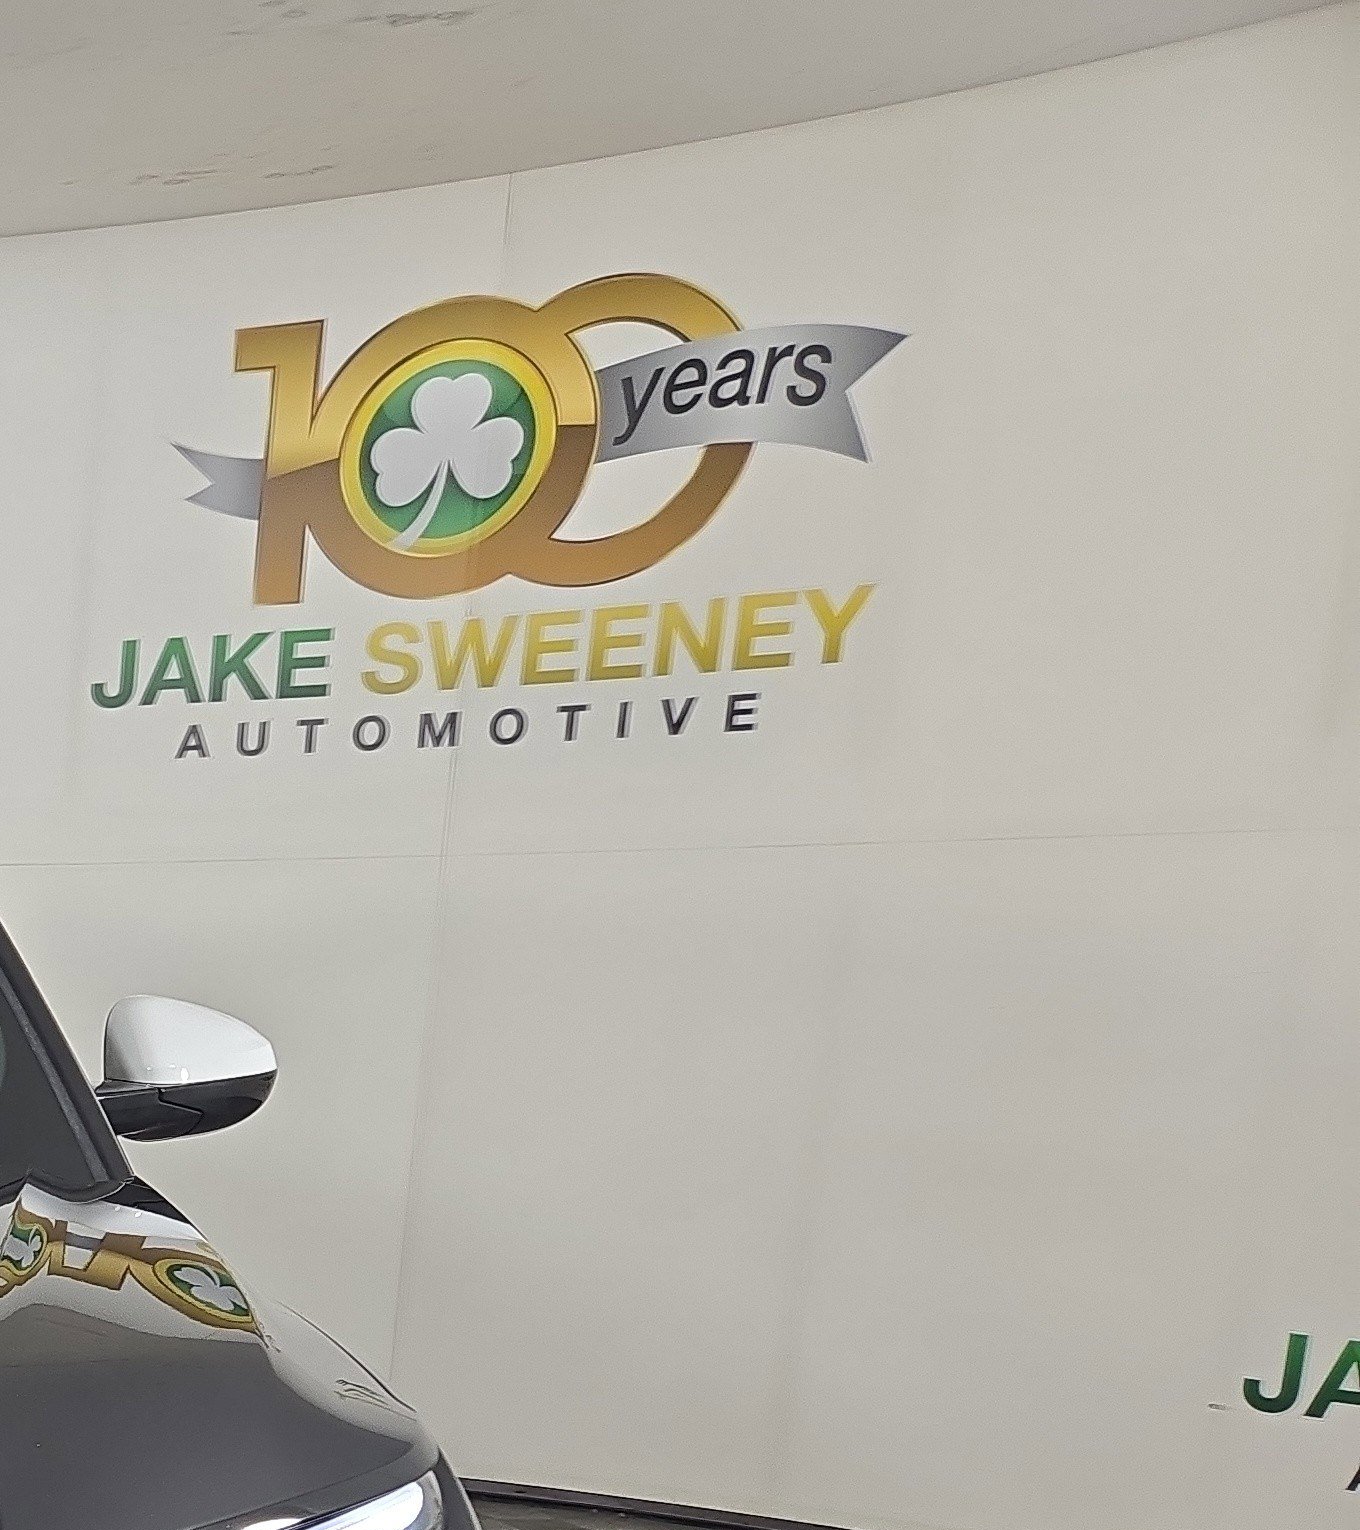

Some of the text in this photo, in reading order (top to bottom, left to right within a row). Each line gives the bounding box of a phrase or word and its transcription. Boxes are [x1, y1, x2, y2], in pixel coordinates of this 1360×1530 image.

[612, 342, 834, 446] years
[90, 583, 878, 711] JAKE SWEENEY
[174, 692, 765, 760] AUTOMOTIVE
